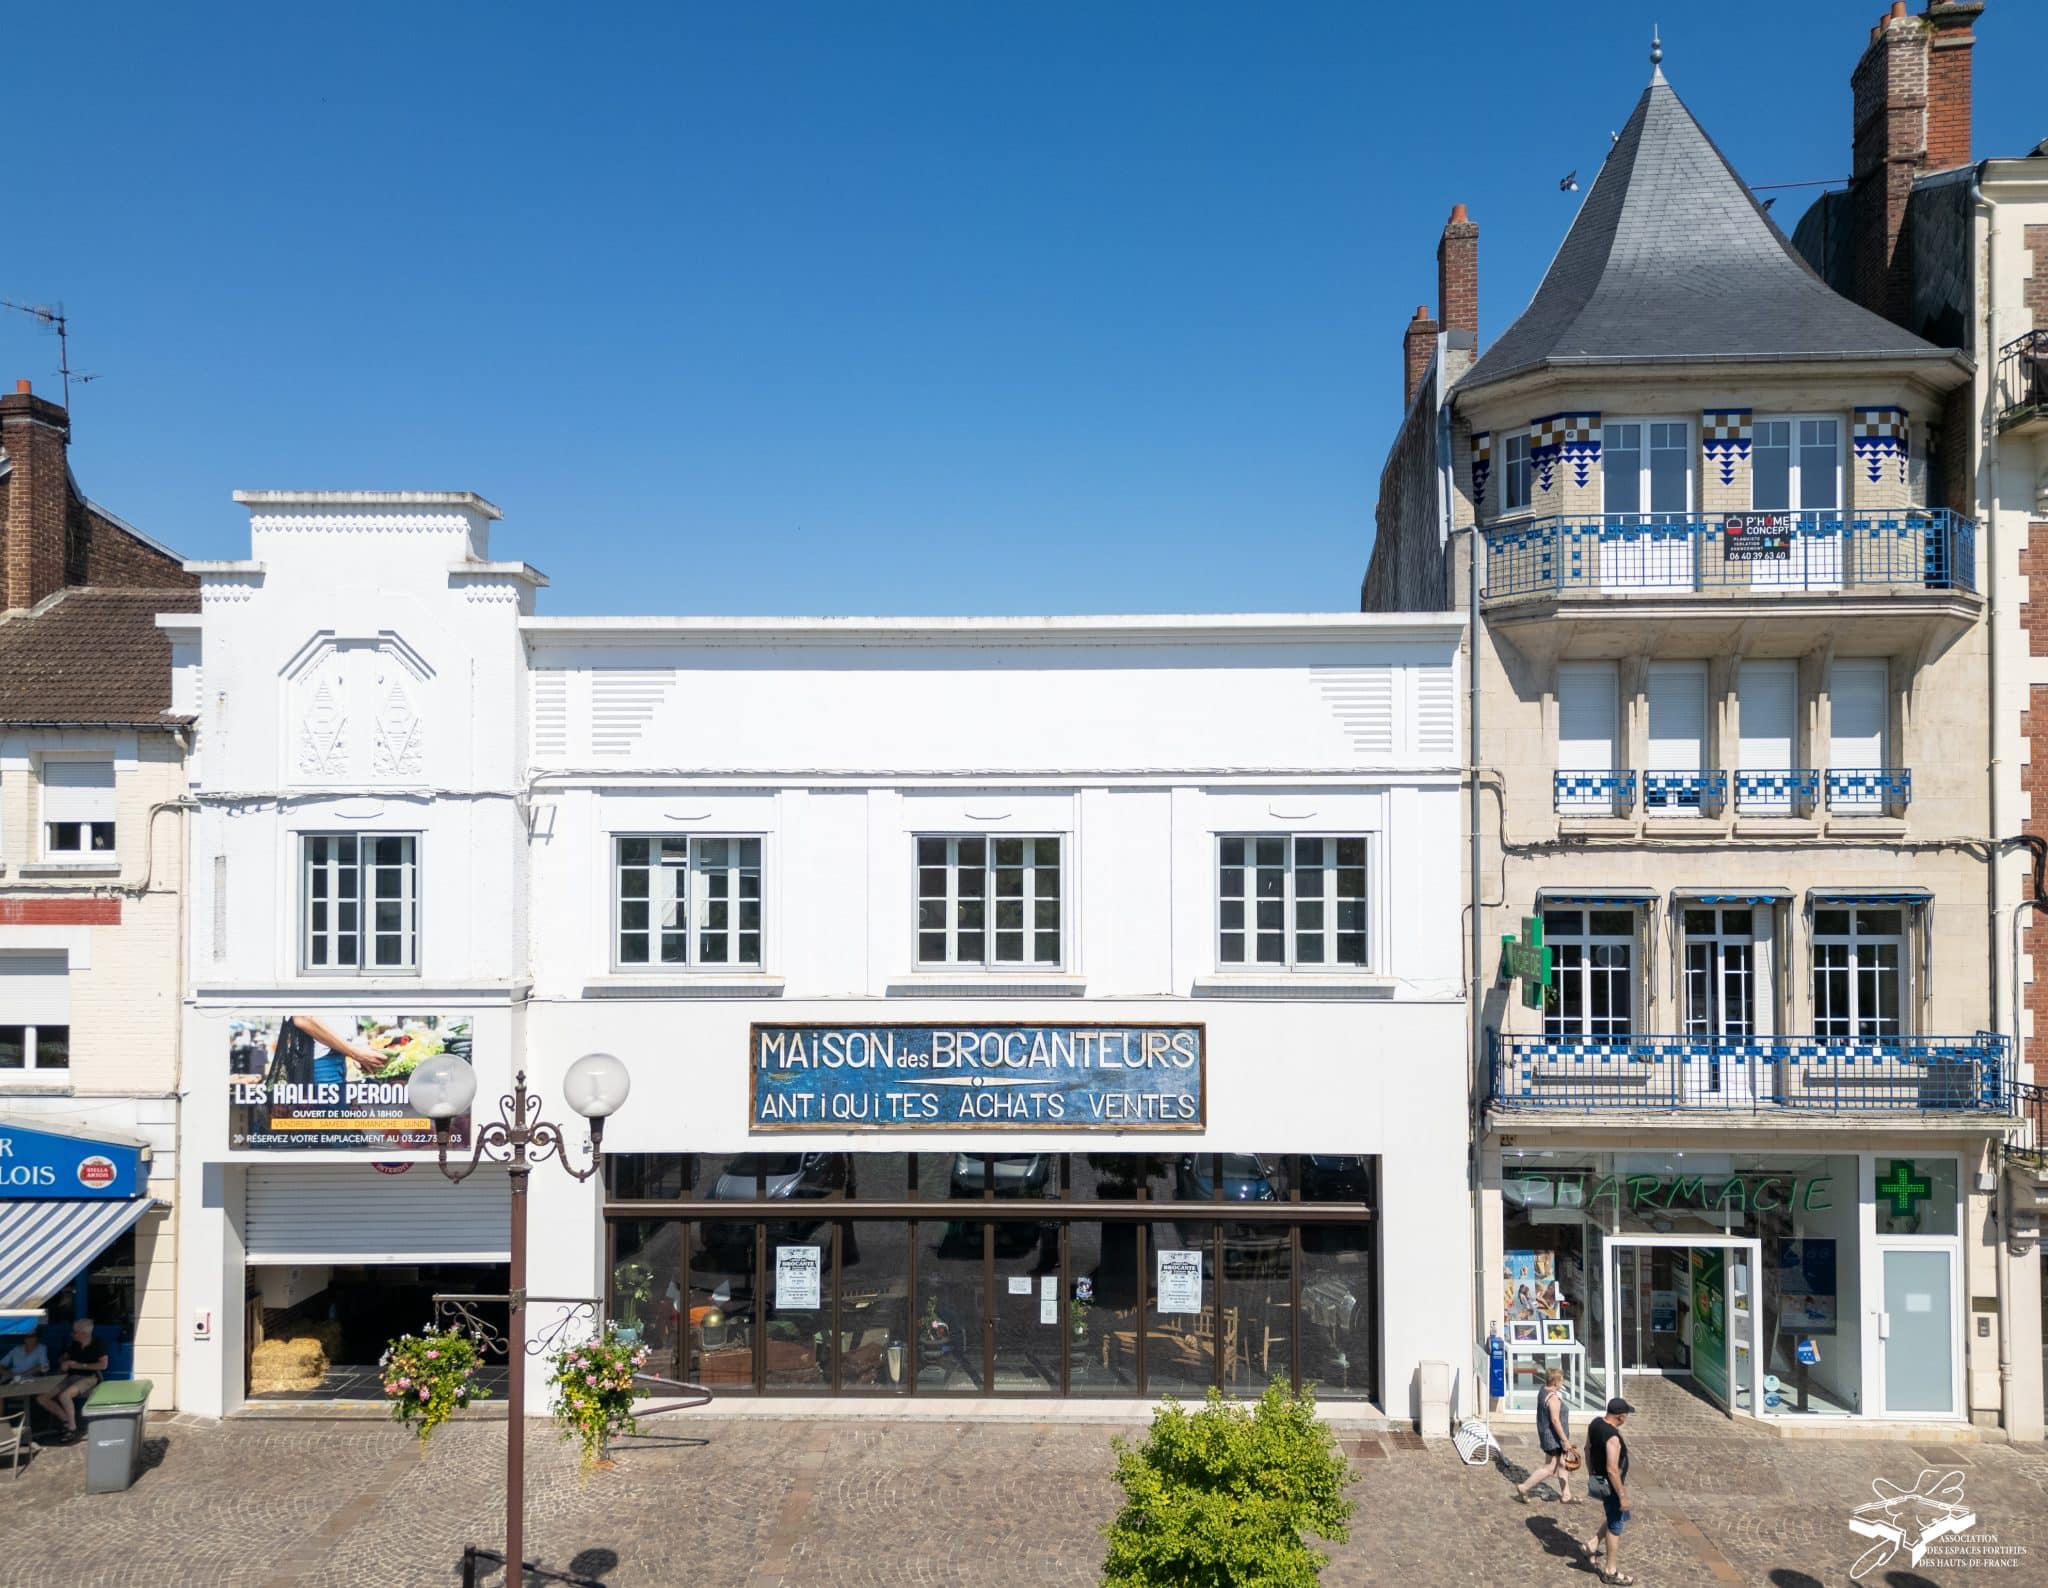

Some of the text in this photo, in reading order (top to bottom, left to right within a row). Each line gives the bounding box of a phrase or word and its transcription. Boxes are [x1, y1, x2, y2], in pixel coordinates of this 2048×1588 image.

[1746, 526, 1789, 535] CONCEPT
[1729, 551, 1786, 560] 06 40 39 63 40
[896, 1047, 929, 1068] des
[932, 1031, 1195, 1068] BROCANTEURS
[235, 1083, 267, 1104] LES
[273, 1083, 340, 1104] HALLES
[958, 1092, 1065, 1119] ACHATS
[1088, 1093, 1196, 1119] VENTES
[292, 1108, 403, 1118] OUVERT DE 10H00 À 18H00
[274, 1120, 428, 1128] VENDREDI SAMEDI DIMANCHE LUNDI
[246, 1133, 289, 1143] RÉSERVEZ
[290, 1134, 319, 1143] VOTRE
[320, 1134, 385, 1143] EMPLACEMENT
[386, 1134, 399, 1142] AU
[1518, 1173, 1834, 1211] PHARMACIE
